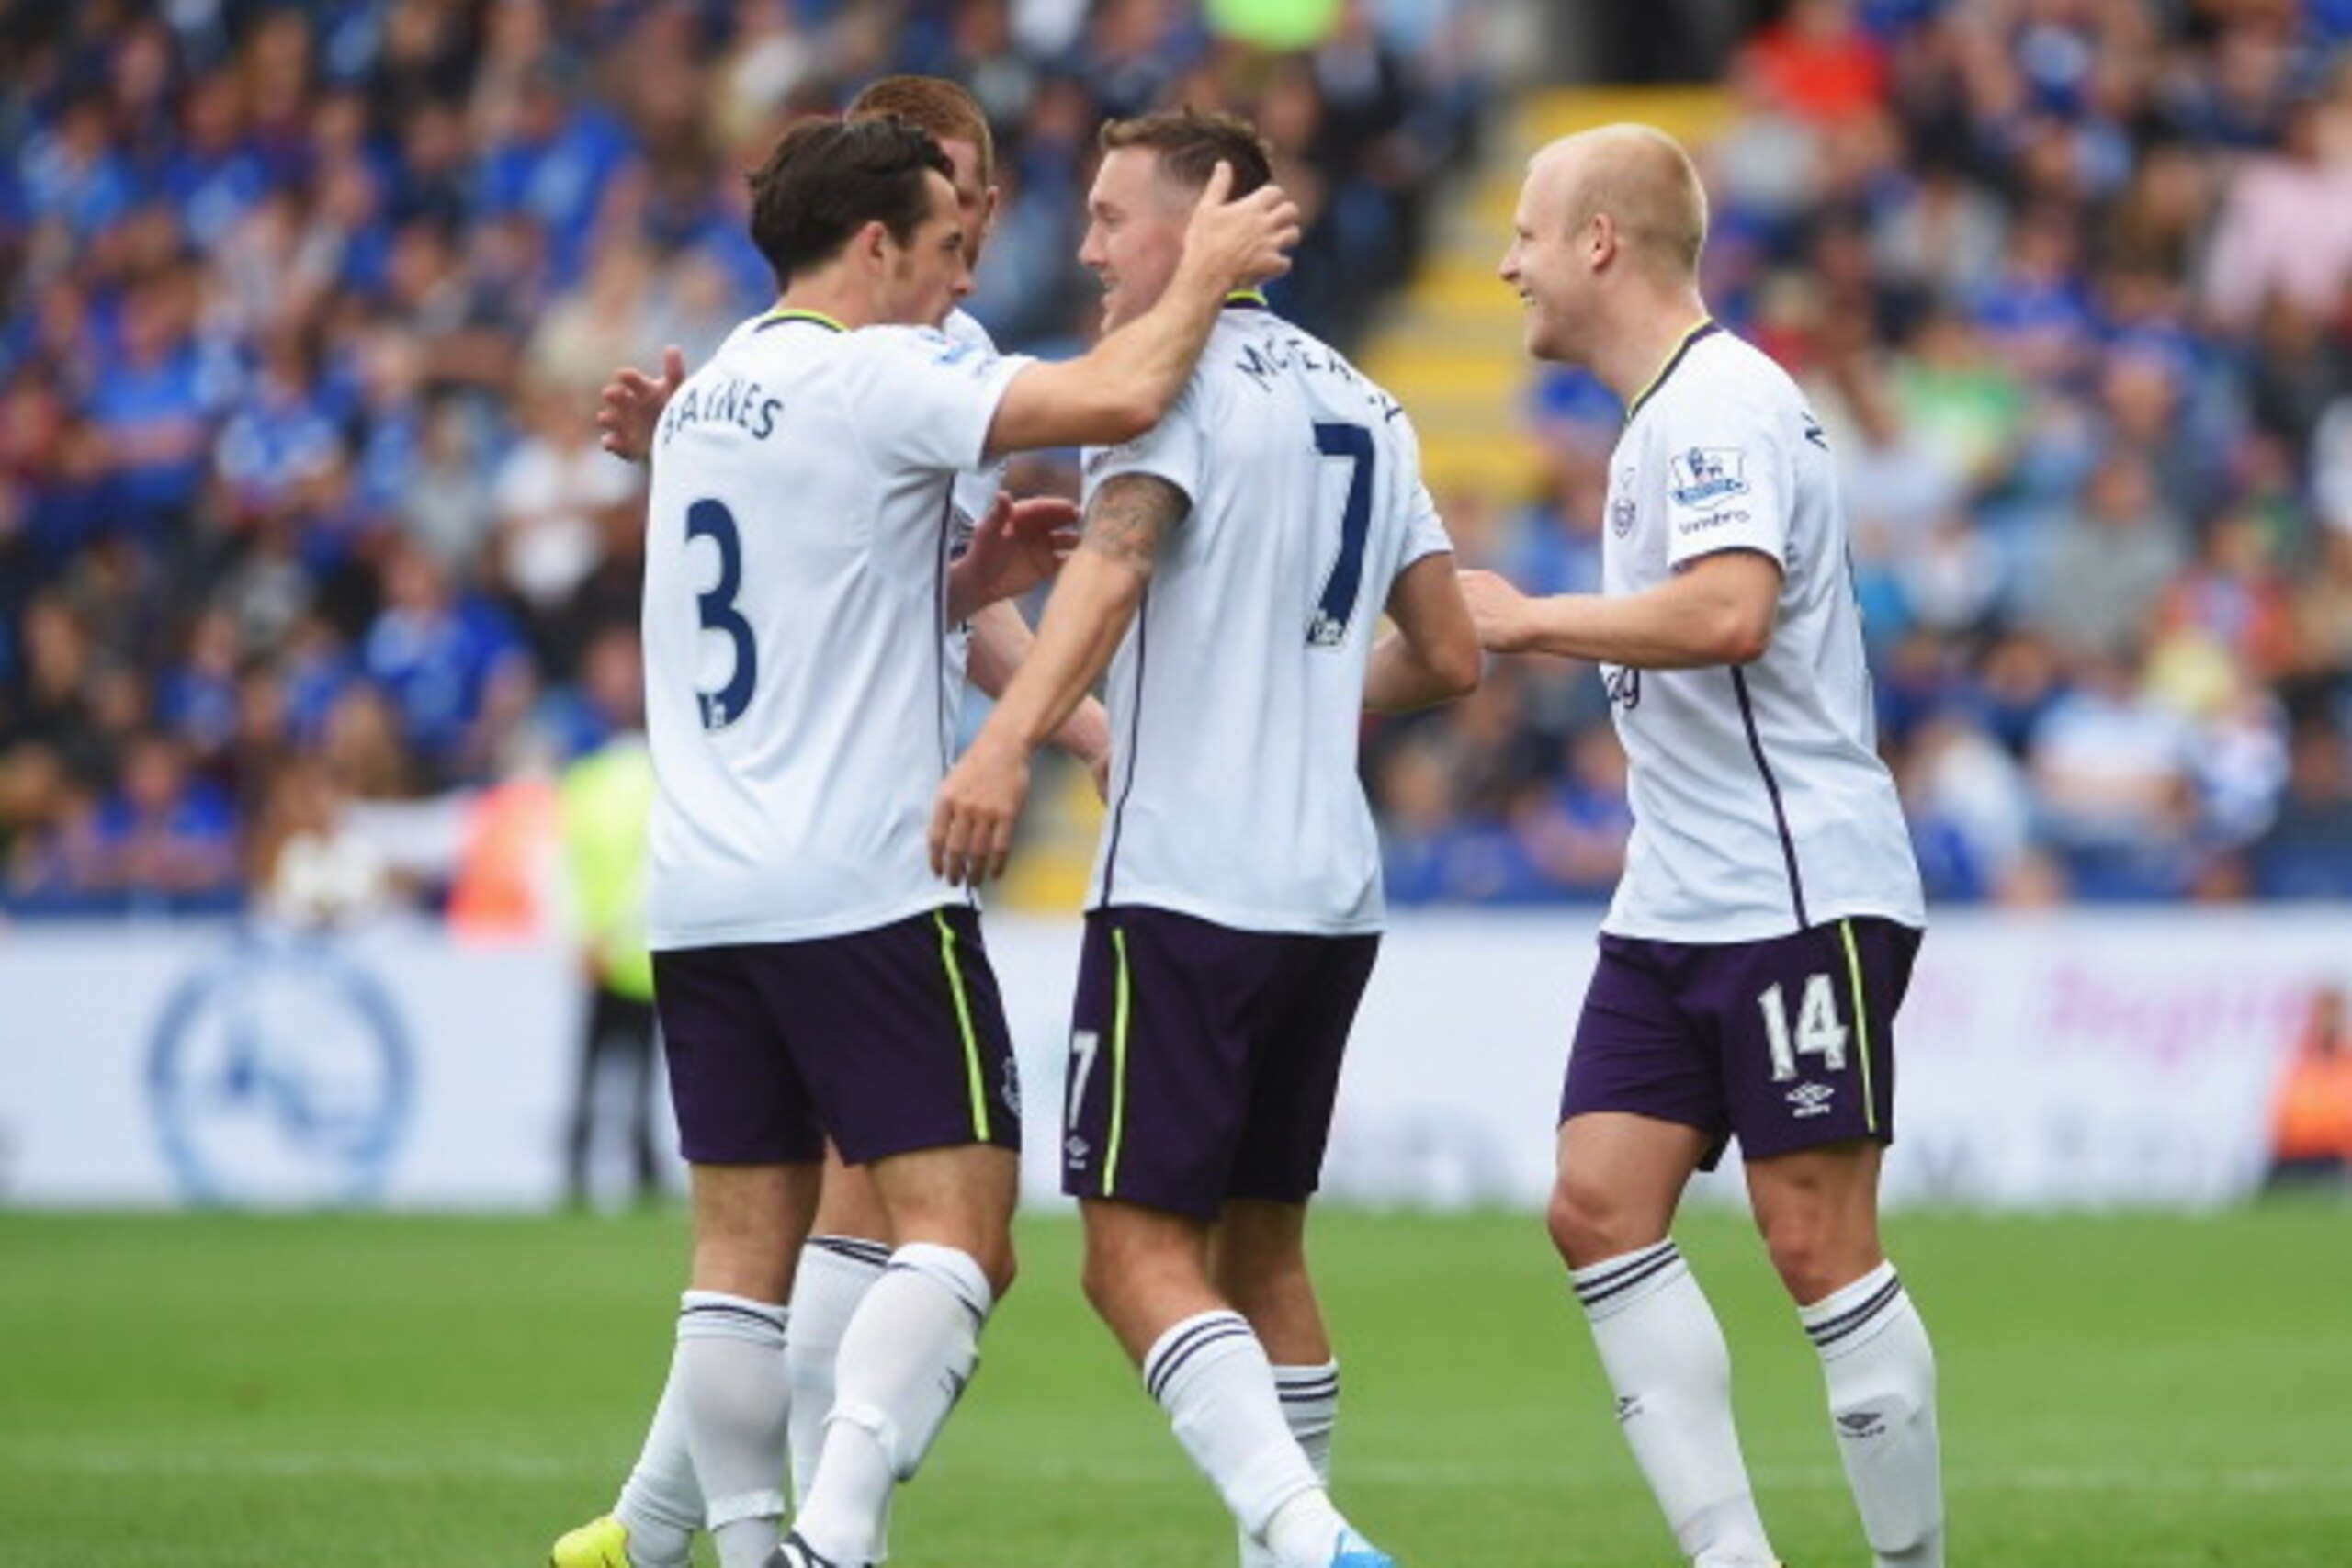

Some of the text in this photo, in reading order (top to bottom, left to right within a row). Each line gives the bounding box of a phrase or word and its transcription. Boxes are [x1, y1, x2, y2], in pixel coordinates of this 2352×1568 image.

[1306, 422, 1375, 647] 7
[1679, 510, 1751, 535] umbro
[684, 497, 757, 730] 3
[1069, 1029, 1099, 1131] 7
[1757, 973, 1849, 1082] 14
